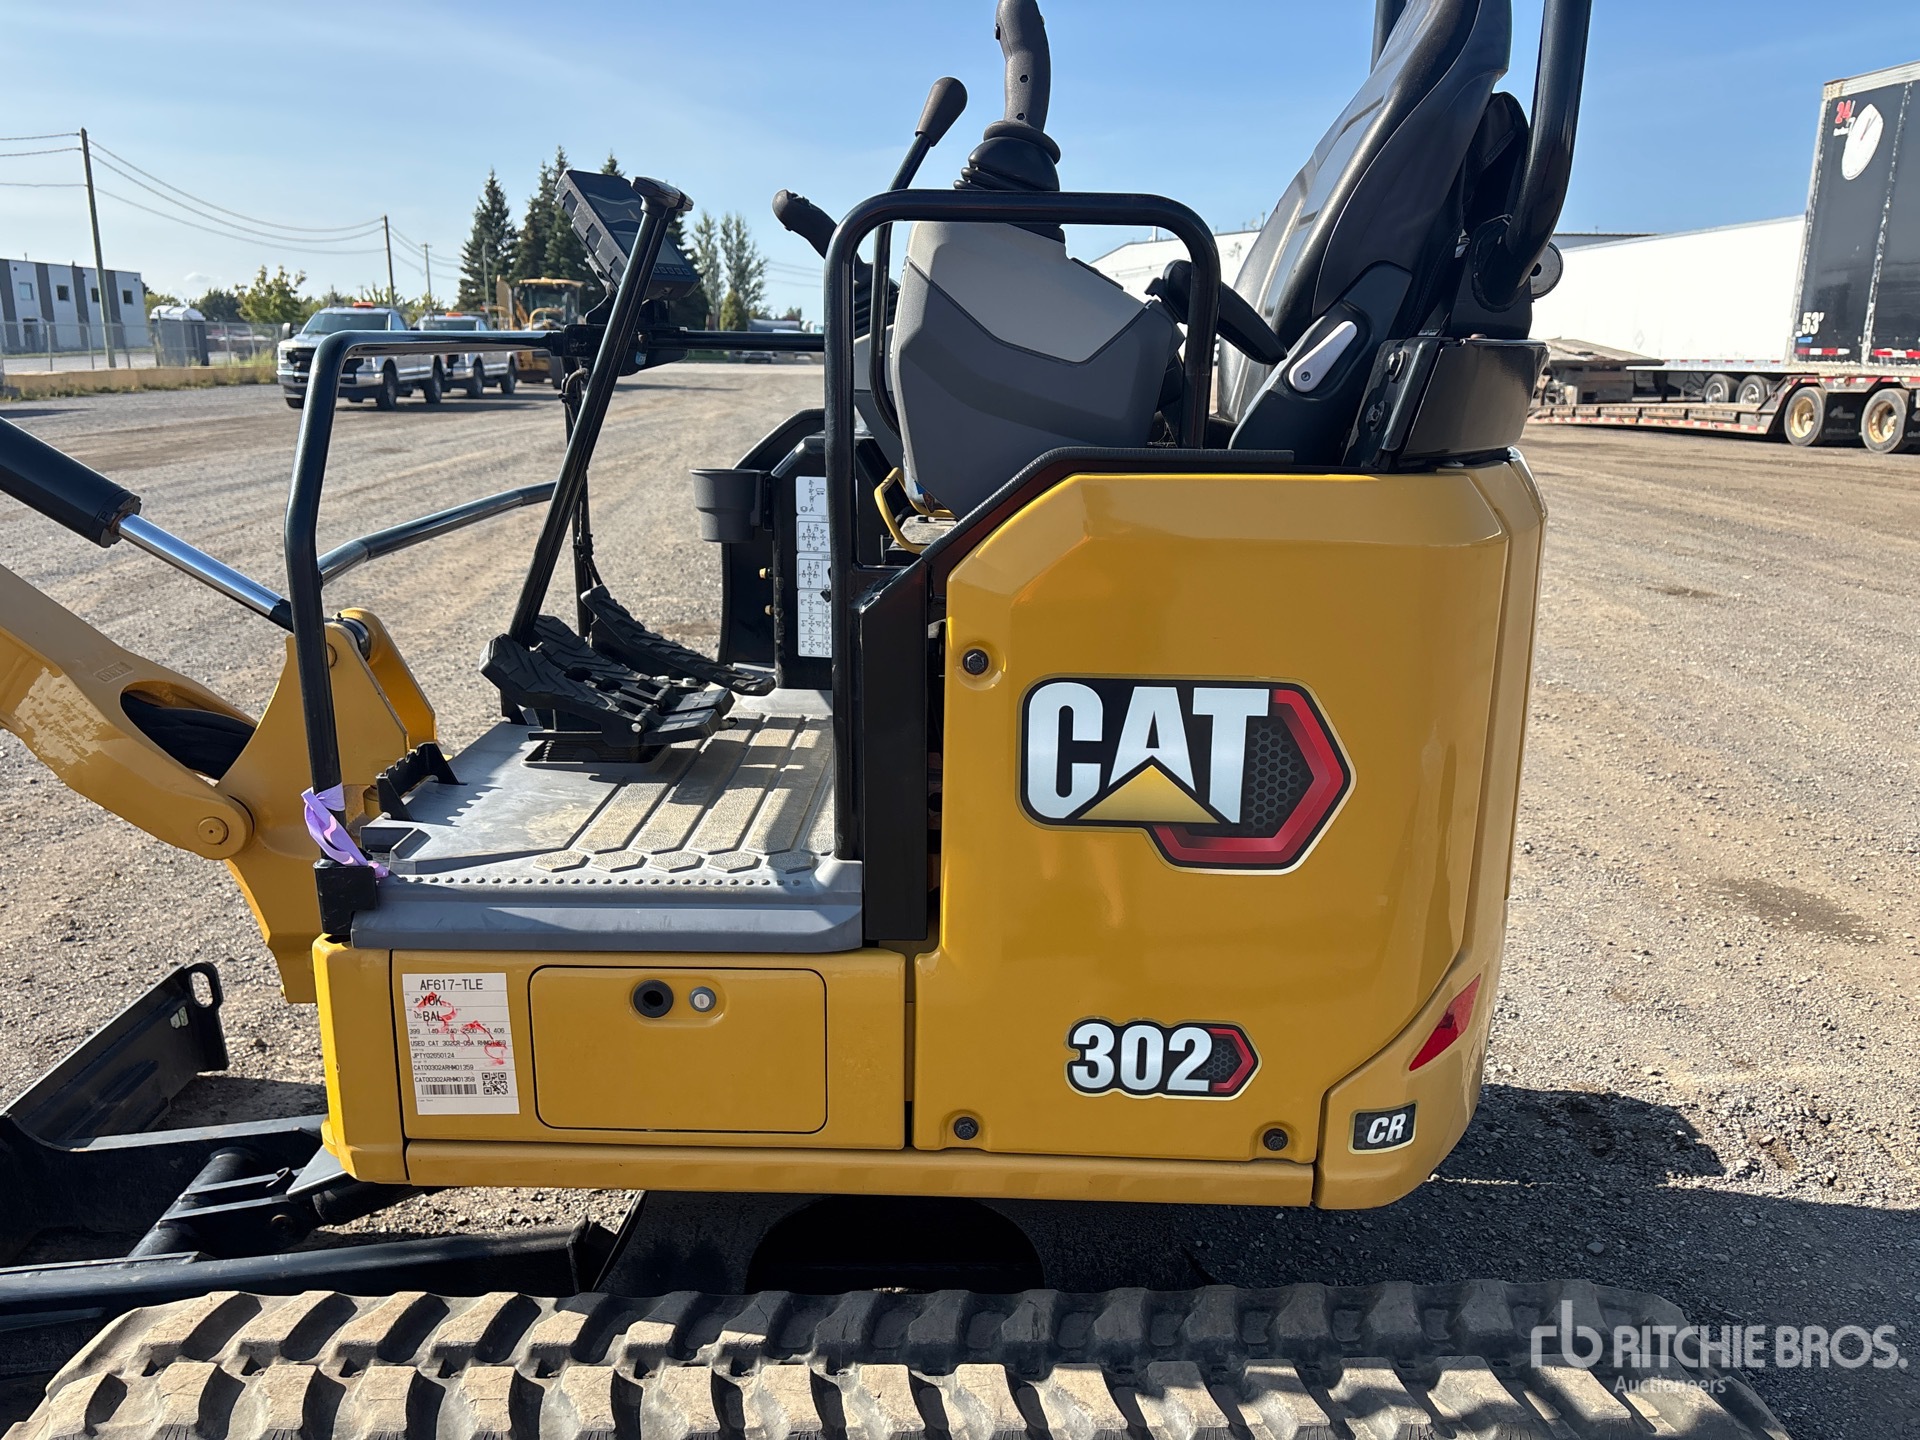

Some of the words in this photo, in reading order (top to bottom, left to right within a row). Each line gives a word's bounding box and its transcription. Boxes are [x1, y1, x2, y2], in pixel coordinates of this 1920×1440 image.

[1027, 682, 1270, 824] CAT
[420, 978, 484, 991] AF617-TLE
[422, 1011, 443, 1022] BAL
[1072, 1022, 1213, 1092] 302
[1367, 1113, 1407, 1144] CR
